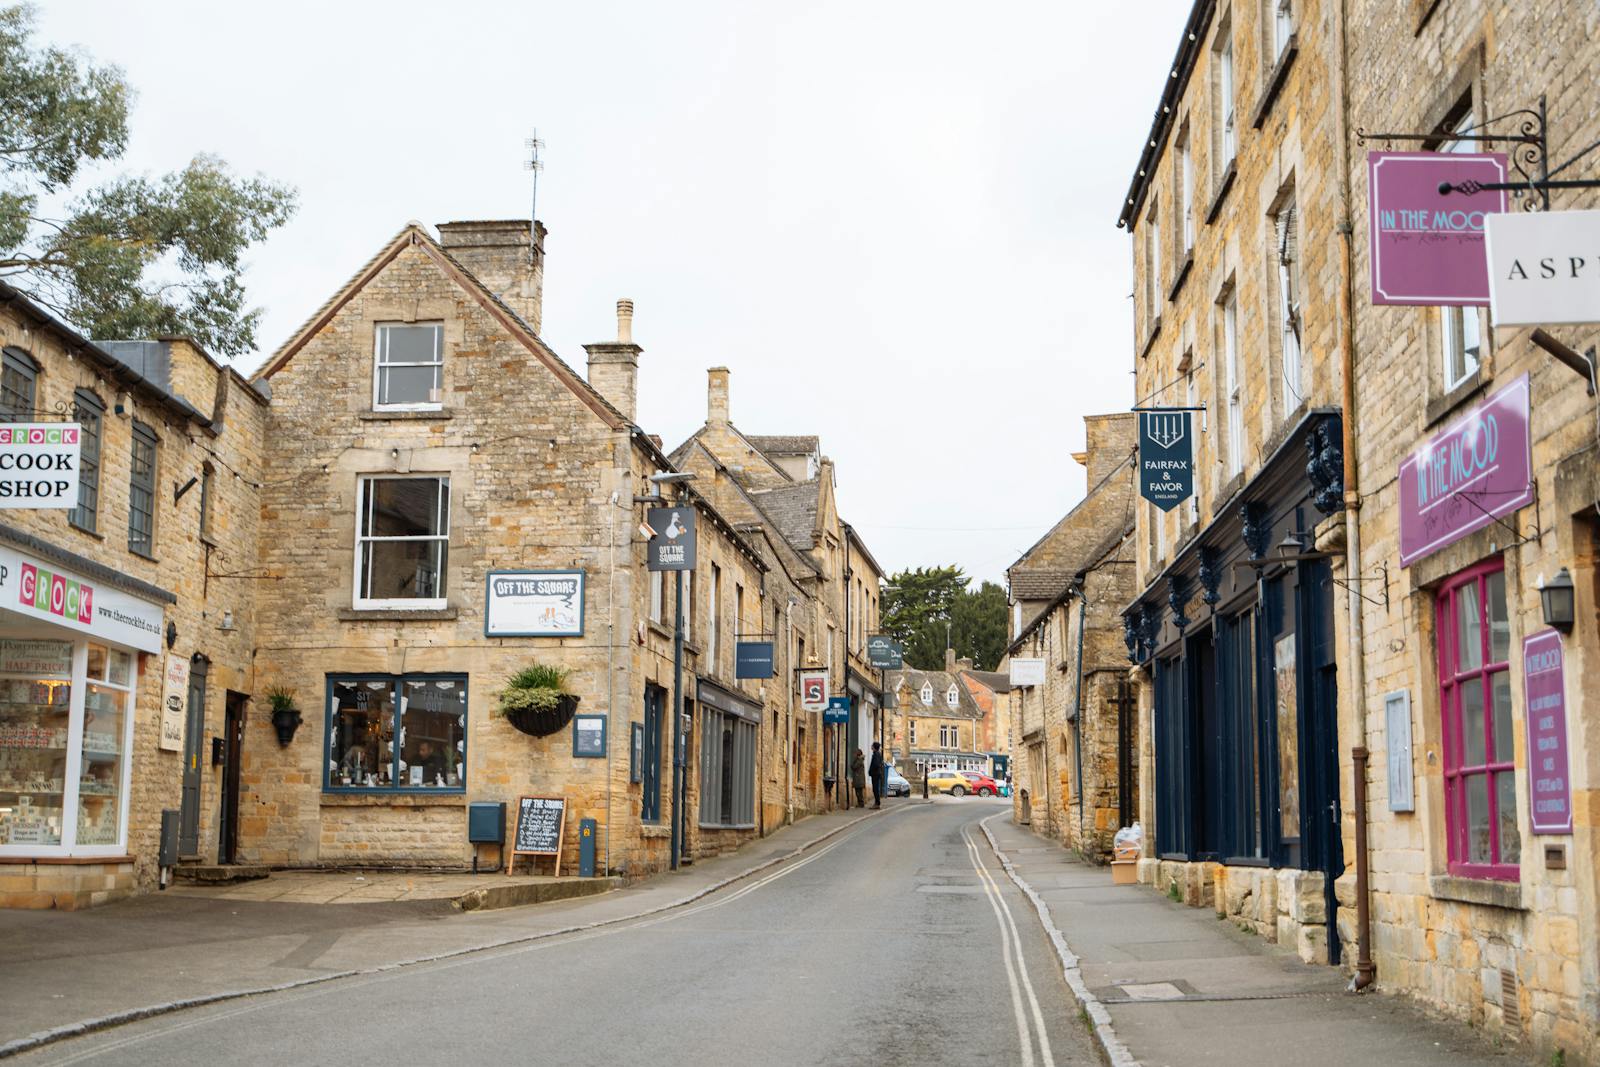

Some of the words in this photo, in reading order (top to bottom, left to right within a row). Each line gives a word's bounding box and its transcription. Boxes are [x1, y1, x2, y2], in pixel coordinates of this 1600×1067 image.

[1381, 209, 1395, 229] IN
[1399, 209, 1428, 230] THE
[1432, 210, 1487, 231] MOO
[1507, 256, 1600, 281] ASP
[0, 453, 73, 470] COOK
[1427, 445, 1449, 500] THE
[1449, 413, 1499, 488] MOOD
[1145, 460, 1187, 470] FAIRFAX
[1162, 471, 1171, 481] &
[0, 480, 70, 497] SHOP
[1150, 482, 1184, 491] FAVOR
[659, 545, 671, 554] OFF
[671, 545, 684, 554] THE
[659, 554, 685, 563] SQUARE
[22, 570, 90, 618] CROCK
[497, 582, 514, 595] OFF
[516, 581, 536, 594] THE
[537, 581, 576, 595] SQUARE
